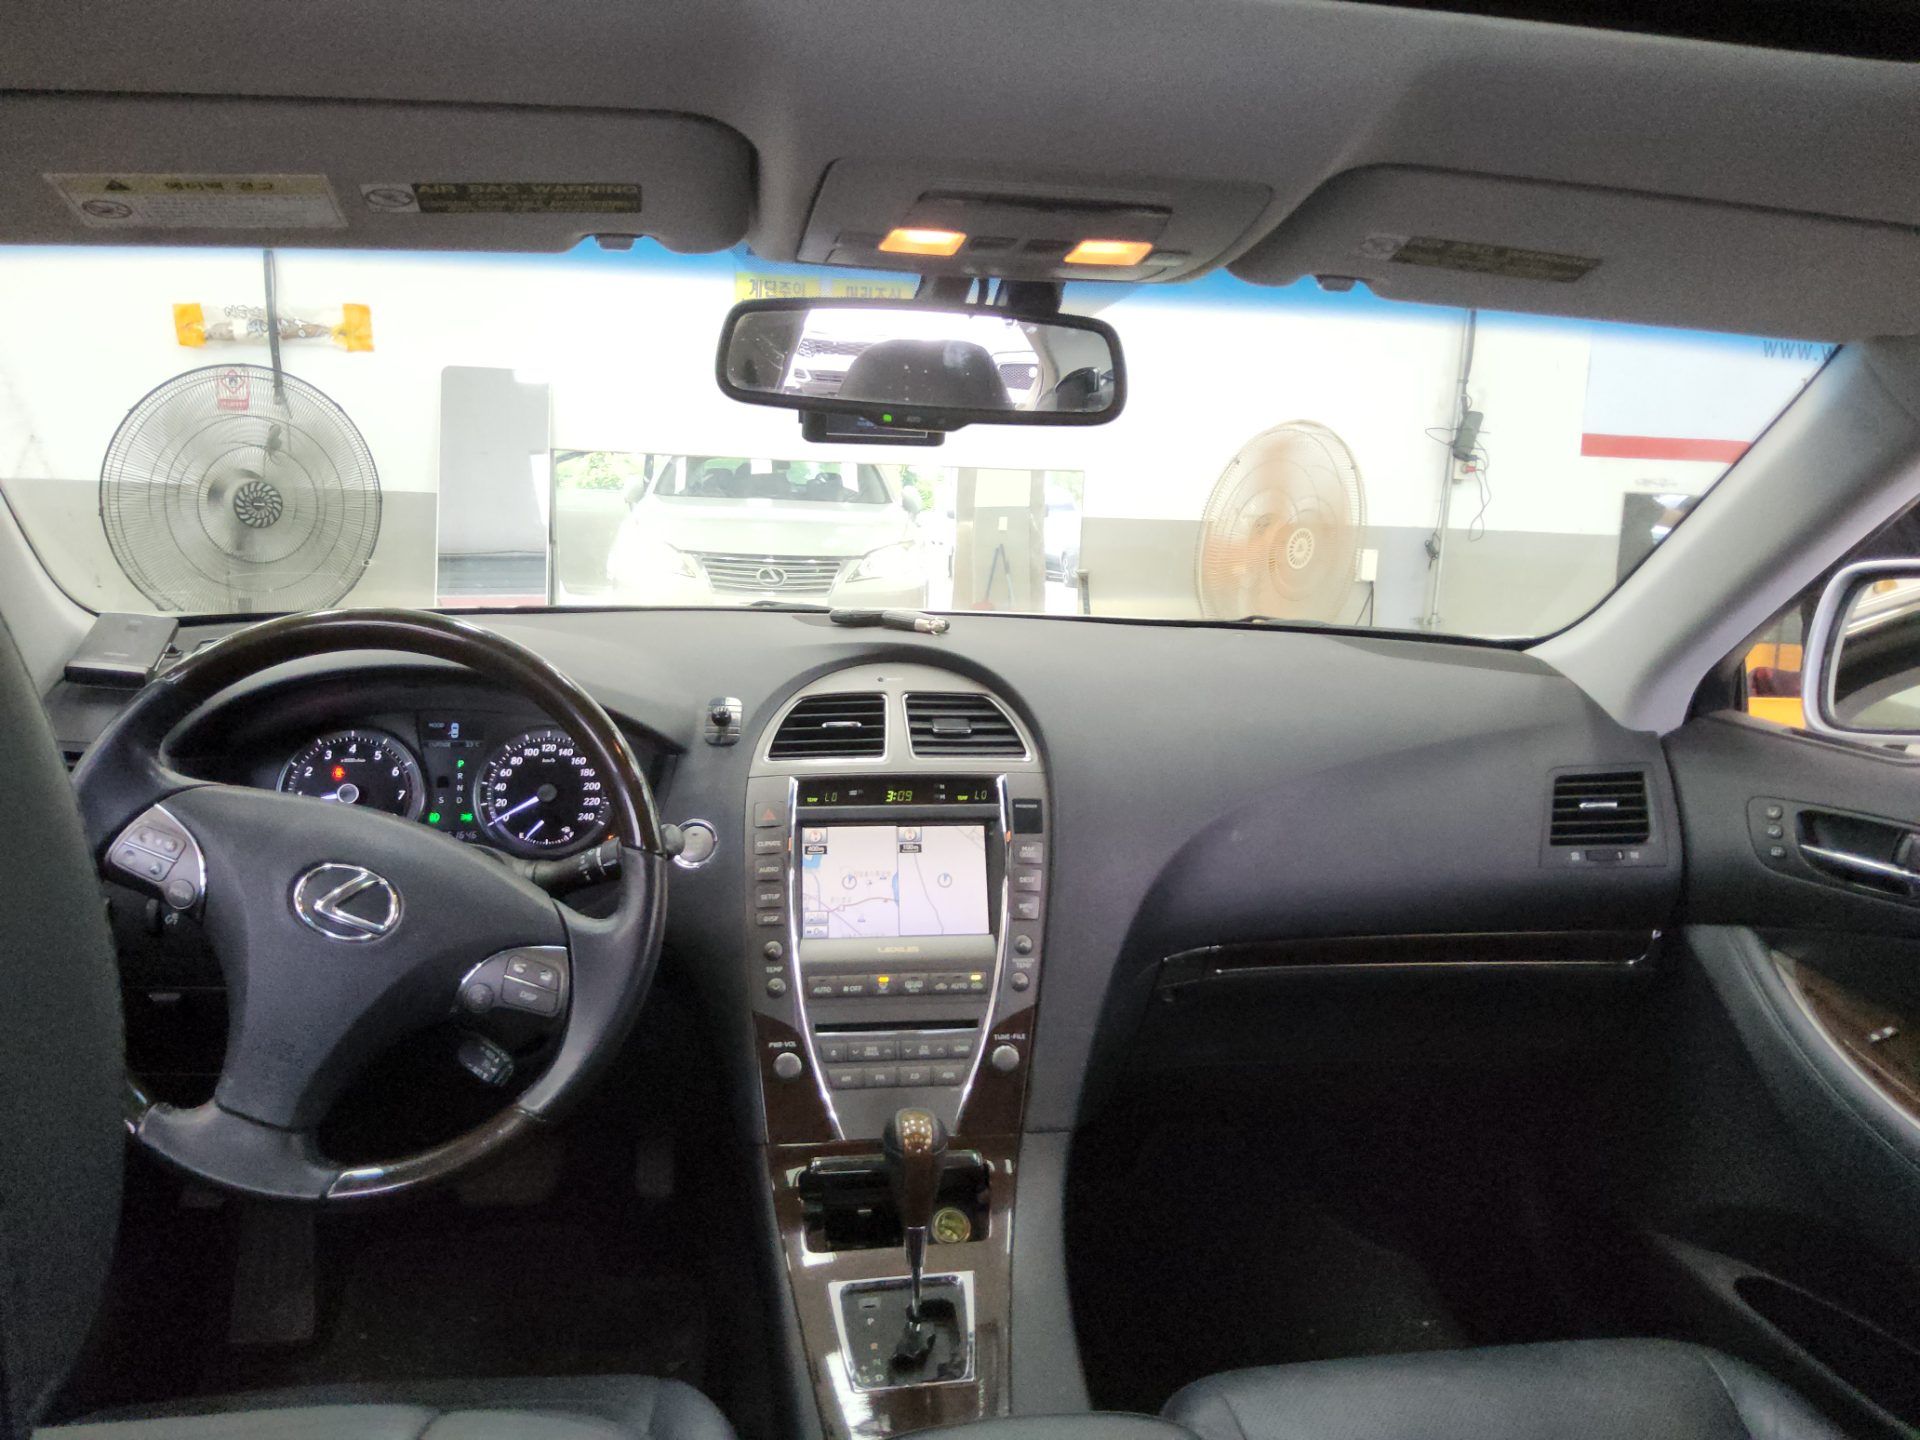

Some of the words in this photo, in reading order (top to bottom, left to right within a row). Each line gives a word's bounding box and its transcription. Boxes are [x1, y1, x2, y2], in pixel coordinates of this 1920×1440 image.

[418, 185, 457, 193] AIR
[467, 185, 519, 193] BAG
[530, 185, 640, 194] WARNING
[349, 744, 357, 754] 4
[524, 748, 539, 757] 100
[542, 744, 556, 752] 120
[559, 748, 573, 757] 140
[324, 750, 332, 760] 3
[374, 750, 382, 760] 5
[457, 759, 465, 768] P
[510, 756, 523, 765] 80
[571, 757, 586, 766] 160
[304, 766, 313, 777] 2
[392, 767, 400, 777] 6
[500, 768, 512, 777] 60
[580, 768, 595, 777] 180
[456, 784, 464, 792] N
[495, 783, 507, 792] 40
[583, 782, 601, 791] 200
[398, 790, 406, 800] 7
[885, 790, 913, 802] 3:09
[495, 799, 507, 808] 20
[583, 797, 600, 806] 220
[577, 812, 594, 821] 240
[950, 982, 968, 990] AUTO
